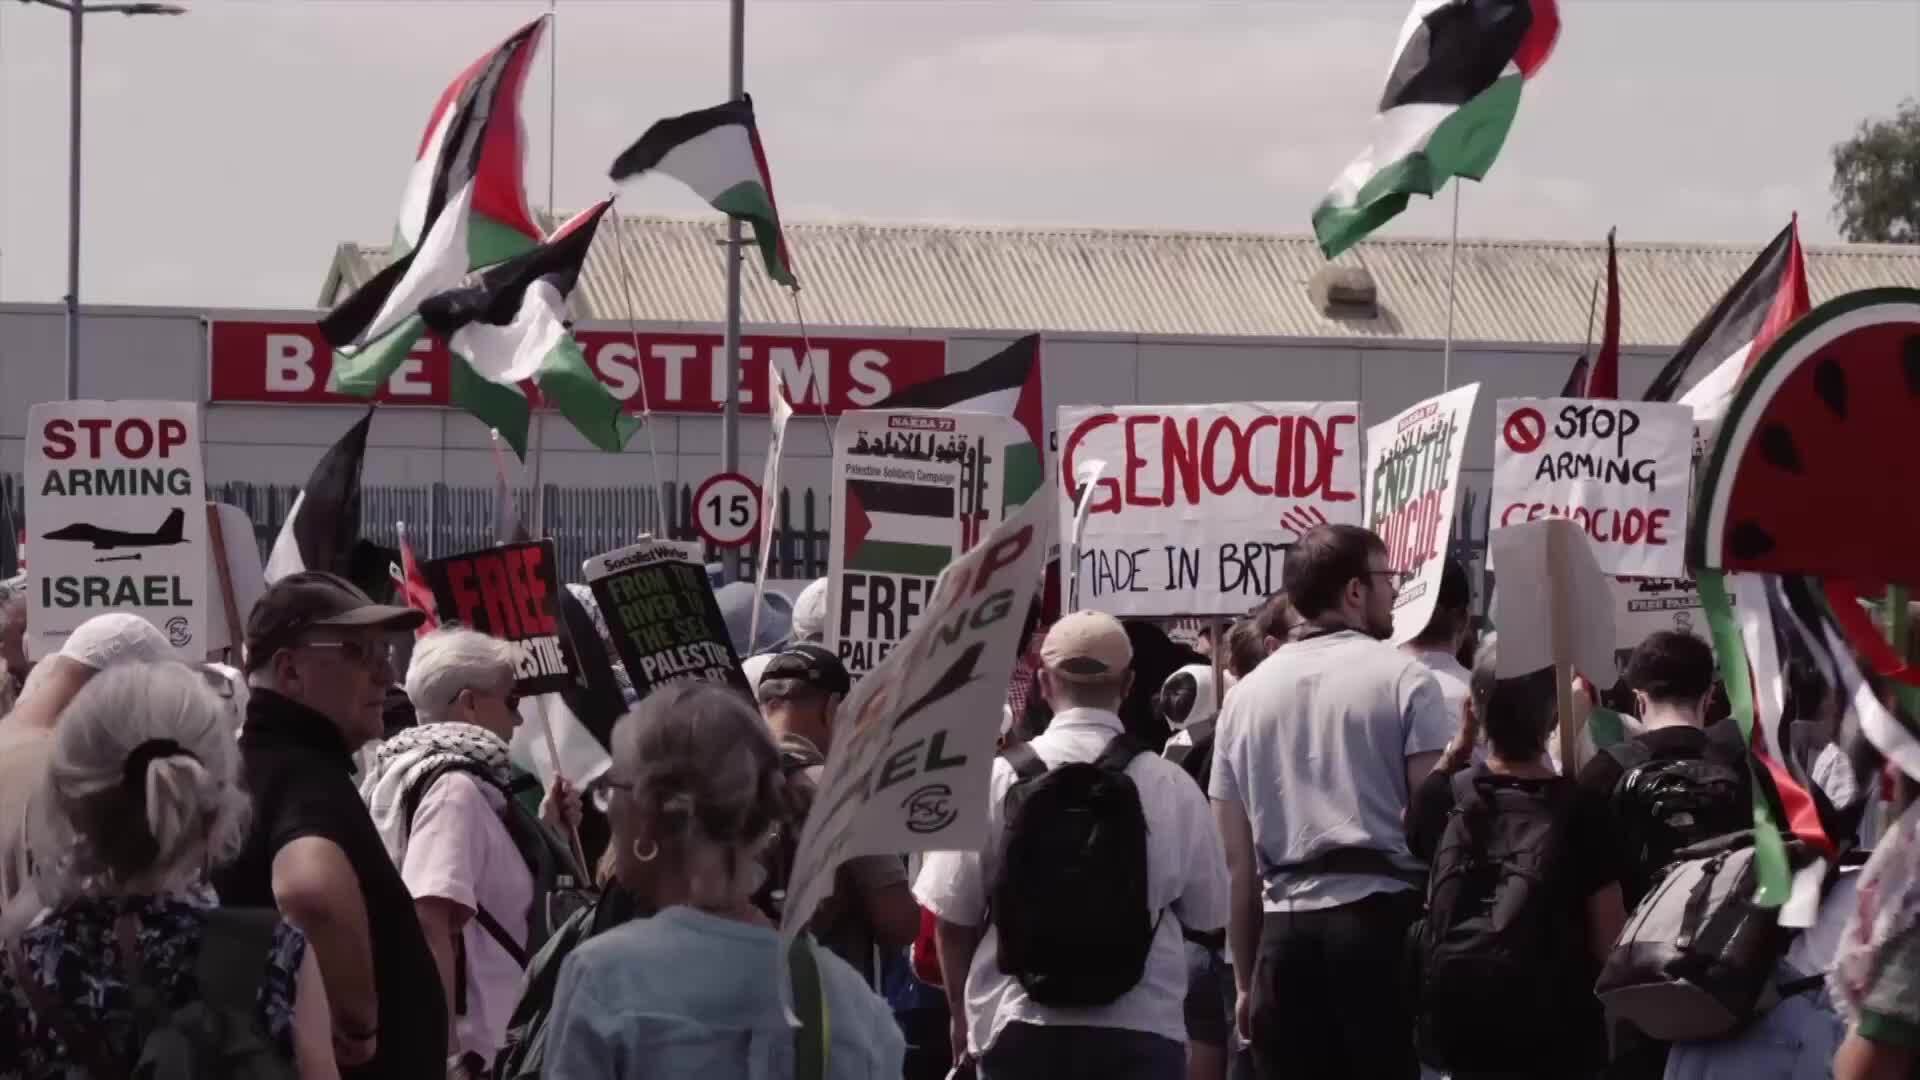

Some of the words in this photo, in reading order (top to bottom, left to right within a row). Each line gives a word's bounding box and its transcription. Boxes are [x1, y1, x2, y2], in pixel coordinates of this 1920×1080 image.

[264, 333, 433, 396] BE
[577, 342, 893, 407] STEMS
[42, 418, 187, 460] STOP
[1554, 405, 1640, 458] STOP
[41, 469, 192, 497] ARMING
[1063, 414, 1356, 514] GENOCIDE
[1535, 452, 1657, 493] ARMING
[706, 496, 750, 528] 15
[608, 568, 669, 604] FROM
[1165, 546, 1200, 591] IN
[42, 576, 193, 608] ISRAEL
[448, 546, 558, 638] FREE
[617, 592, 681, 631] RIVER
[513, 636, 569, 681] ESTINE
[628, 622, 674, 656] THE
[640, 640, 735, 682] PALESTINE
